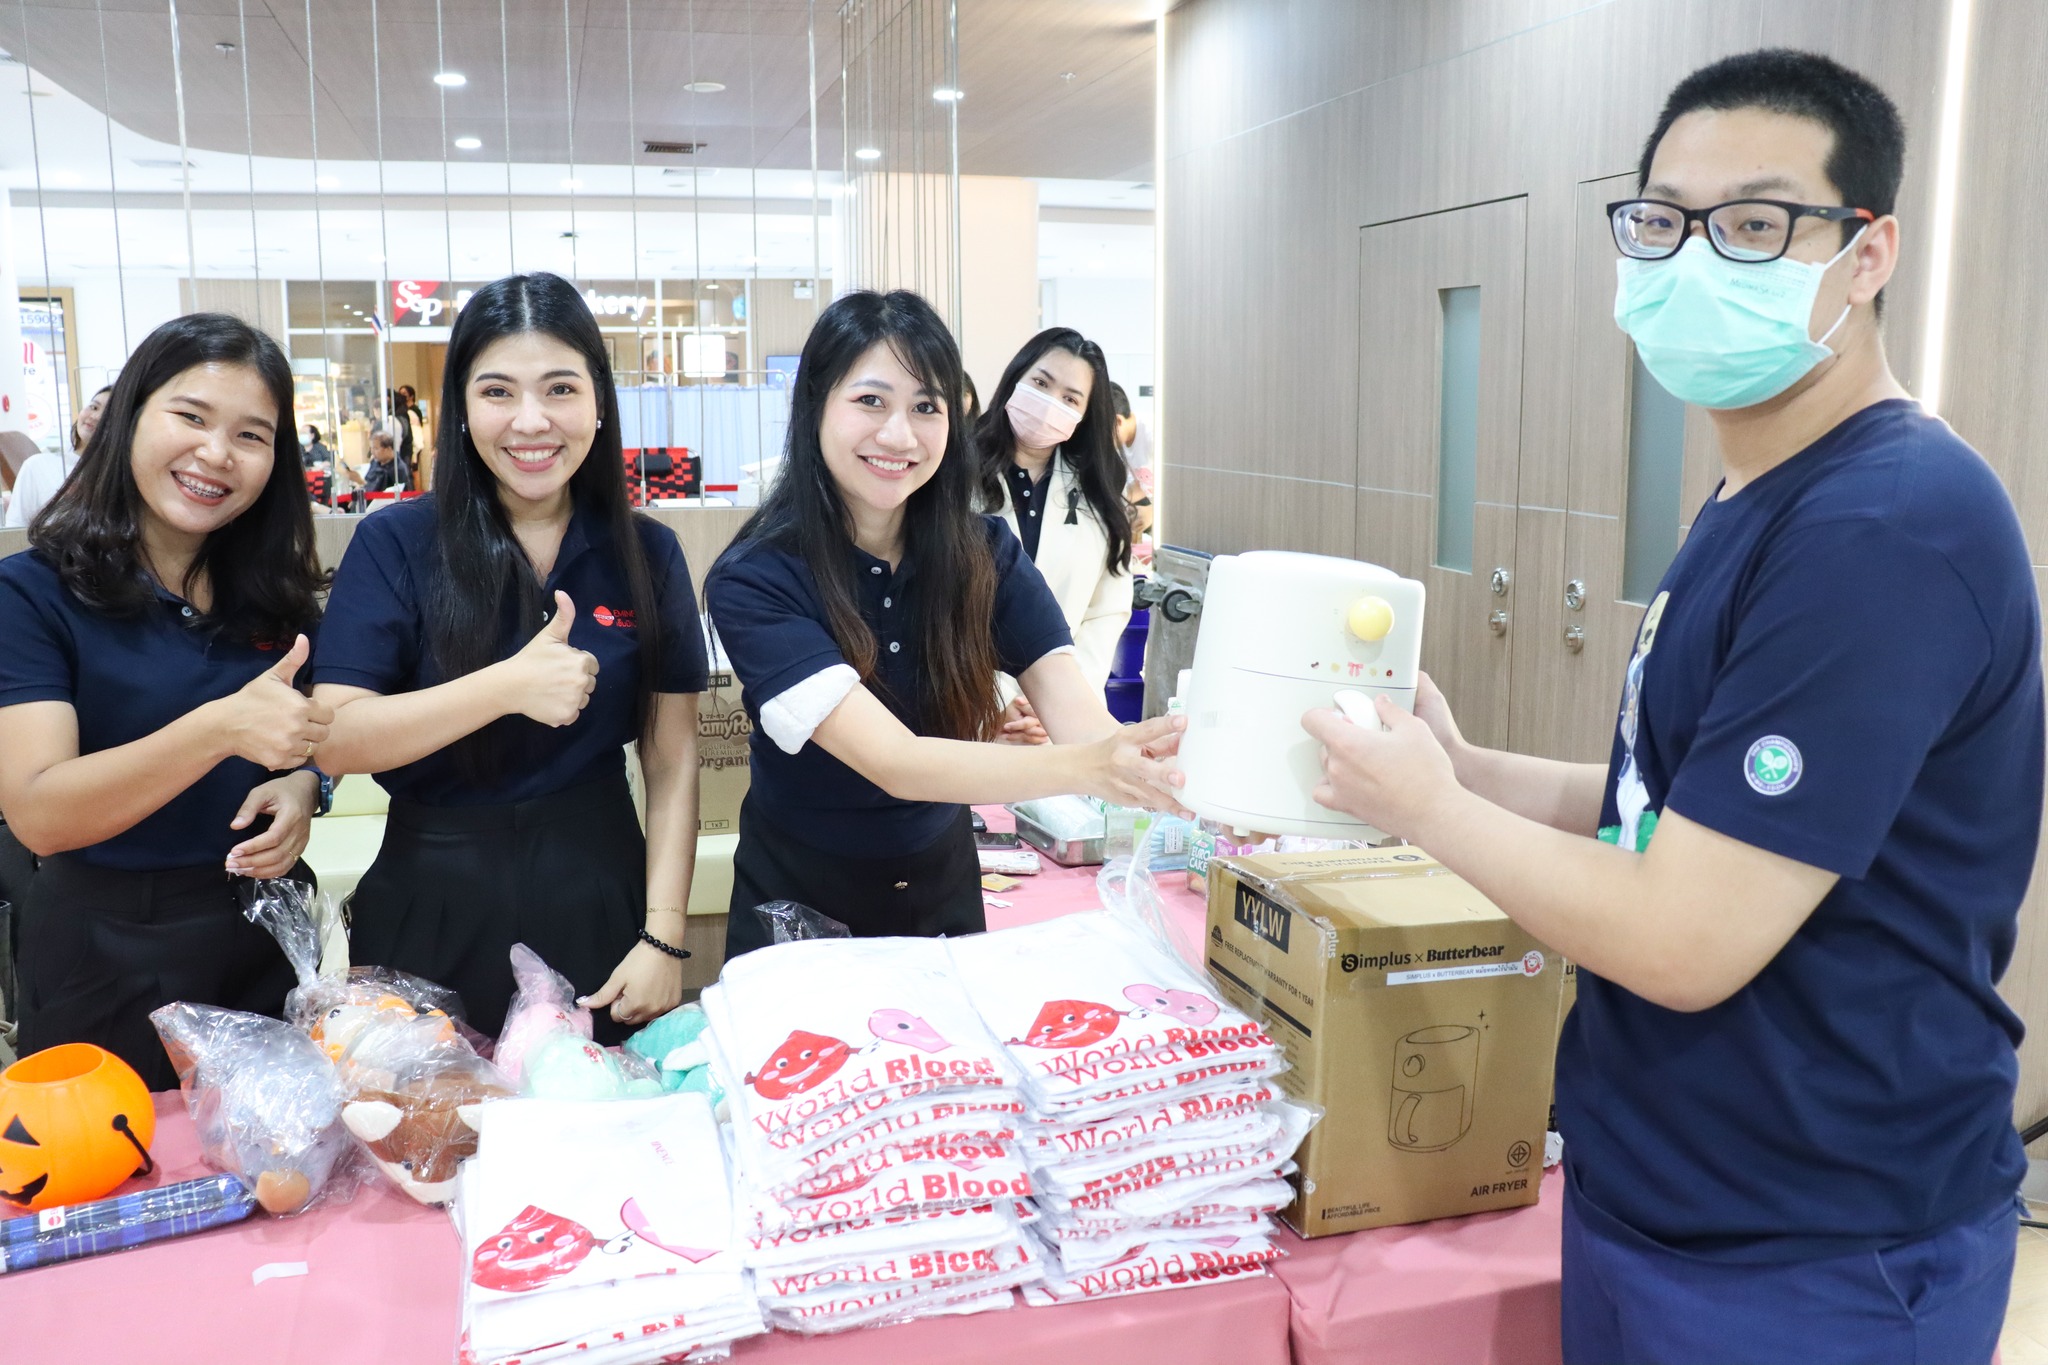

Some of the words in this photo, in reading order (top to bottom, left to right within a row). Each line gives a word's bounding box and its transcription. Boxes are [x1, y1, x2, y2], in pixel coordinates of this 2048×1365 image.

[1189, 857, 1207, 872] CAKE
[1242, 890, 1284, 942] YYLW
[1341, 952, 1411, 973] Simplus
[1426, 944, 1505, 962] Butterbear
[1406, 972, 1431, 980] SIMPLUS
[1437, 968, 1474, 978] BUTTERBEAR
[752, 1068, 878, 1135] World
[782, 1178, 914, 1223] World
[921, 1171, 1034, 1200] Blood
[1470, 1185, 1489, 1197] AIR
[1492, 1179, 1528, 1194] FRYER
[772, 1260, 903, 1297] World
